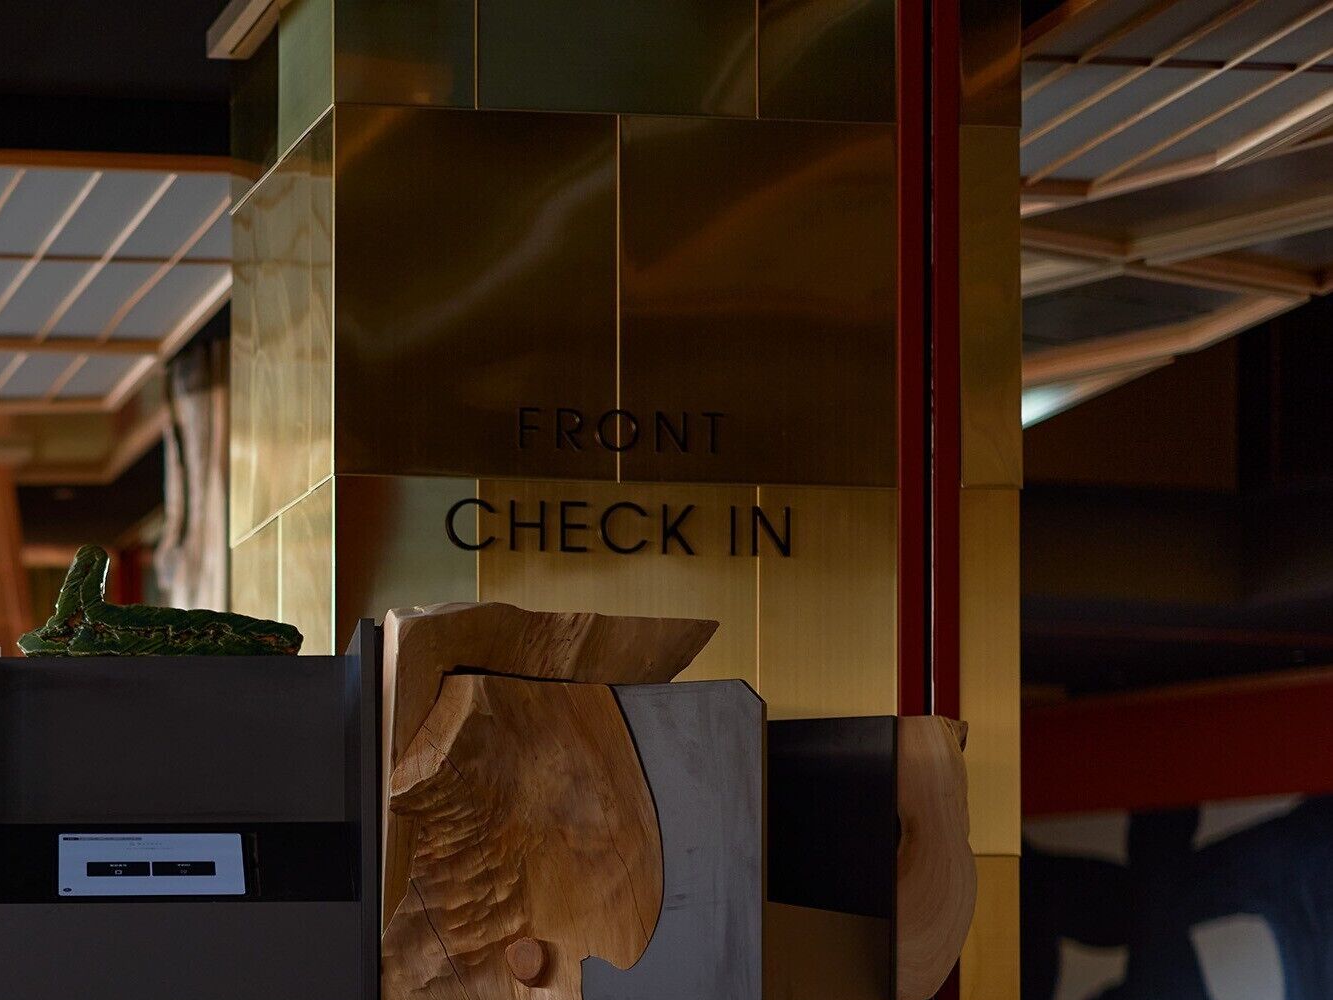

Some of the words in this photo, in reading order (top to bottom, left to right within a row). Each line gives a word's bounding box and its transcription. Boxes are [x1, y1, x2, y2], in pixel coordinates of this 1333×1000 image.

[518, 407, 725, 454] FRONT
[445, 498, 696, 556] CHECK
[730, 505, 791, 557] IN
